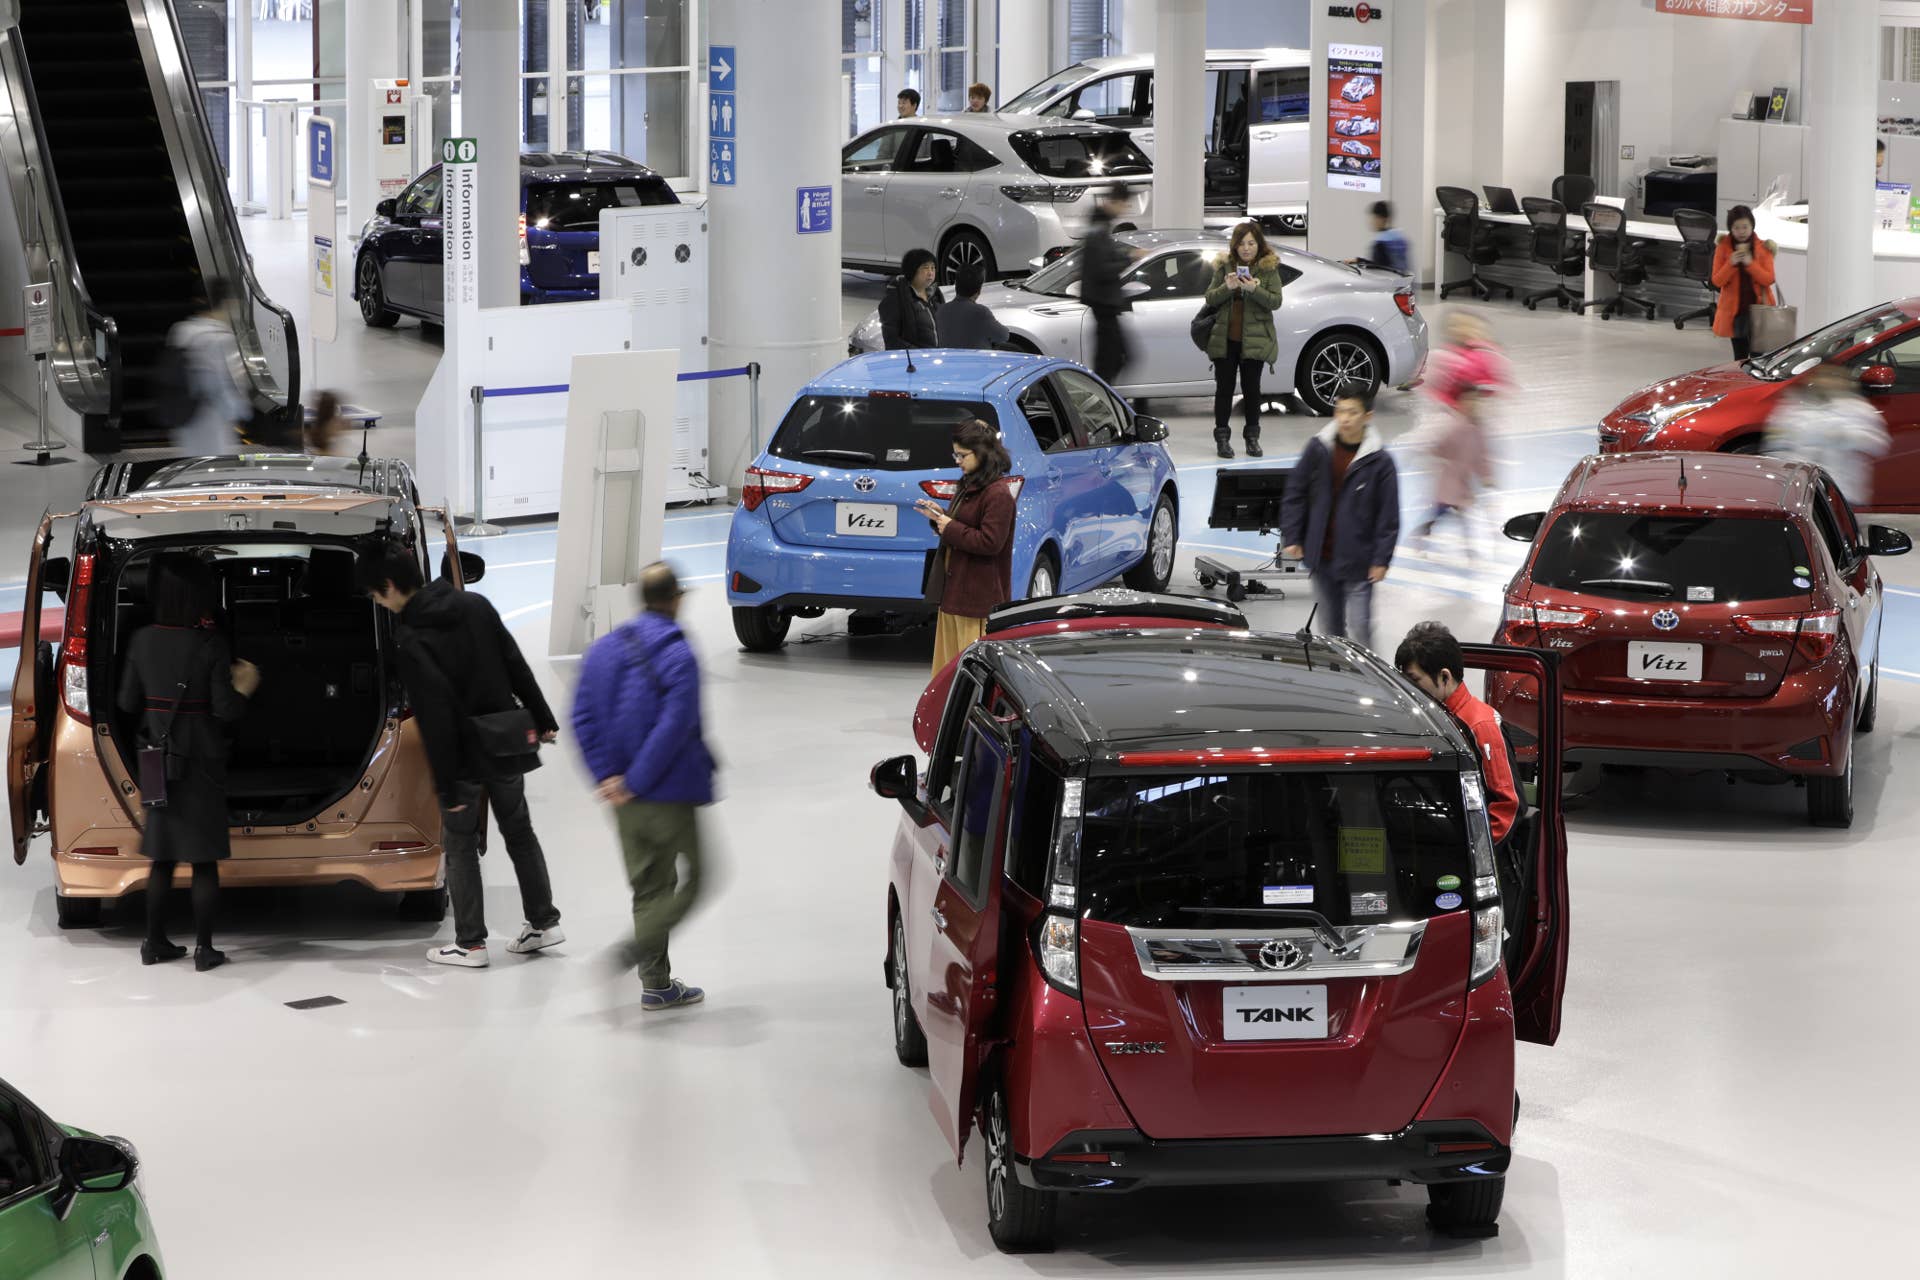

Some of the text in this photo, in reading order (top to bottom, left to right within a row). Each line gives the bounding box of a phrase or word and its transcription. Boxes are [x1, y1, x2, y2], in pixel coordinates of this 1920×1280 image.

[318, 130, 326, 162] F
[446, 169, 454, 260] Information
[462, 169, 473, 260] Information
[772, 500, 791, 509] Vitz
[848, 513, 885, 528] Vitz
[1550, 638, 1574, 648] Vitz
[1642, 653, 1688, 671] Vitz
[1236, 1007, 1315, 1023] TANK
[1105, 1042, 1166, 1054] TANK
